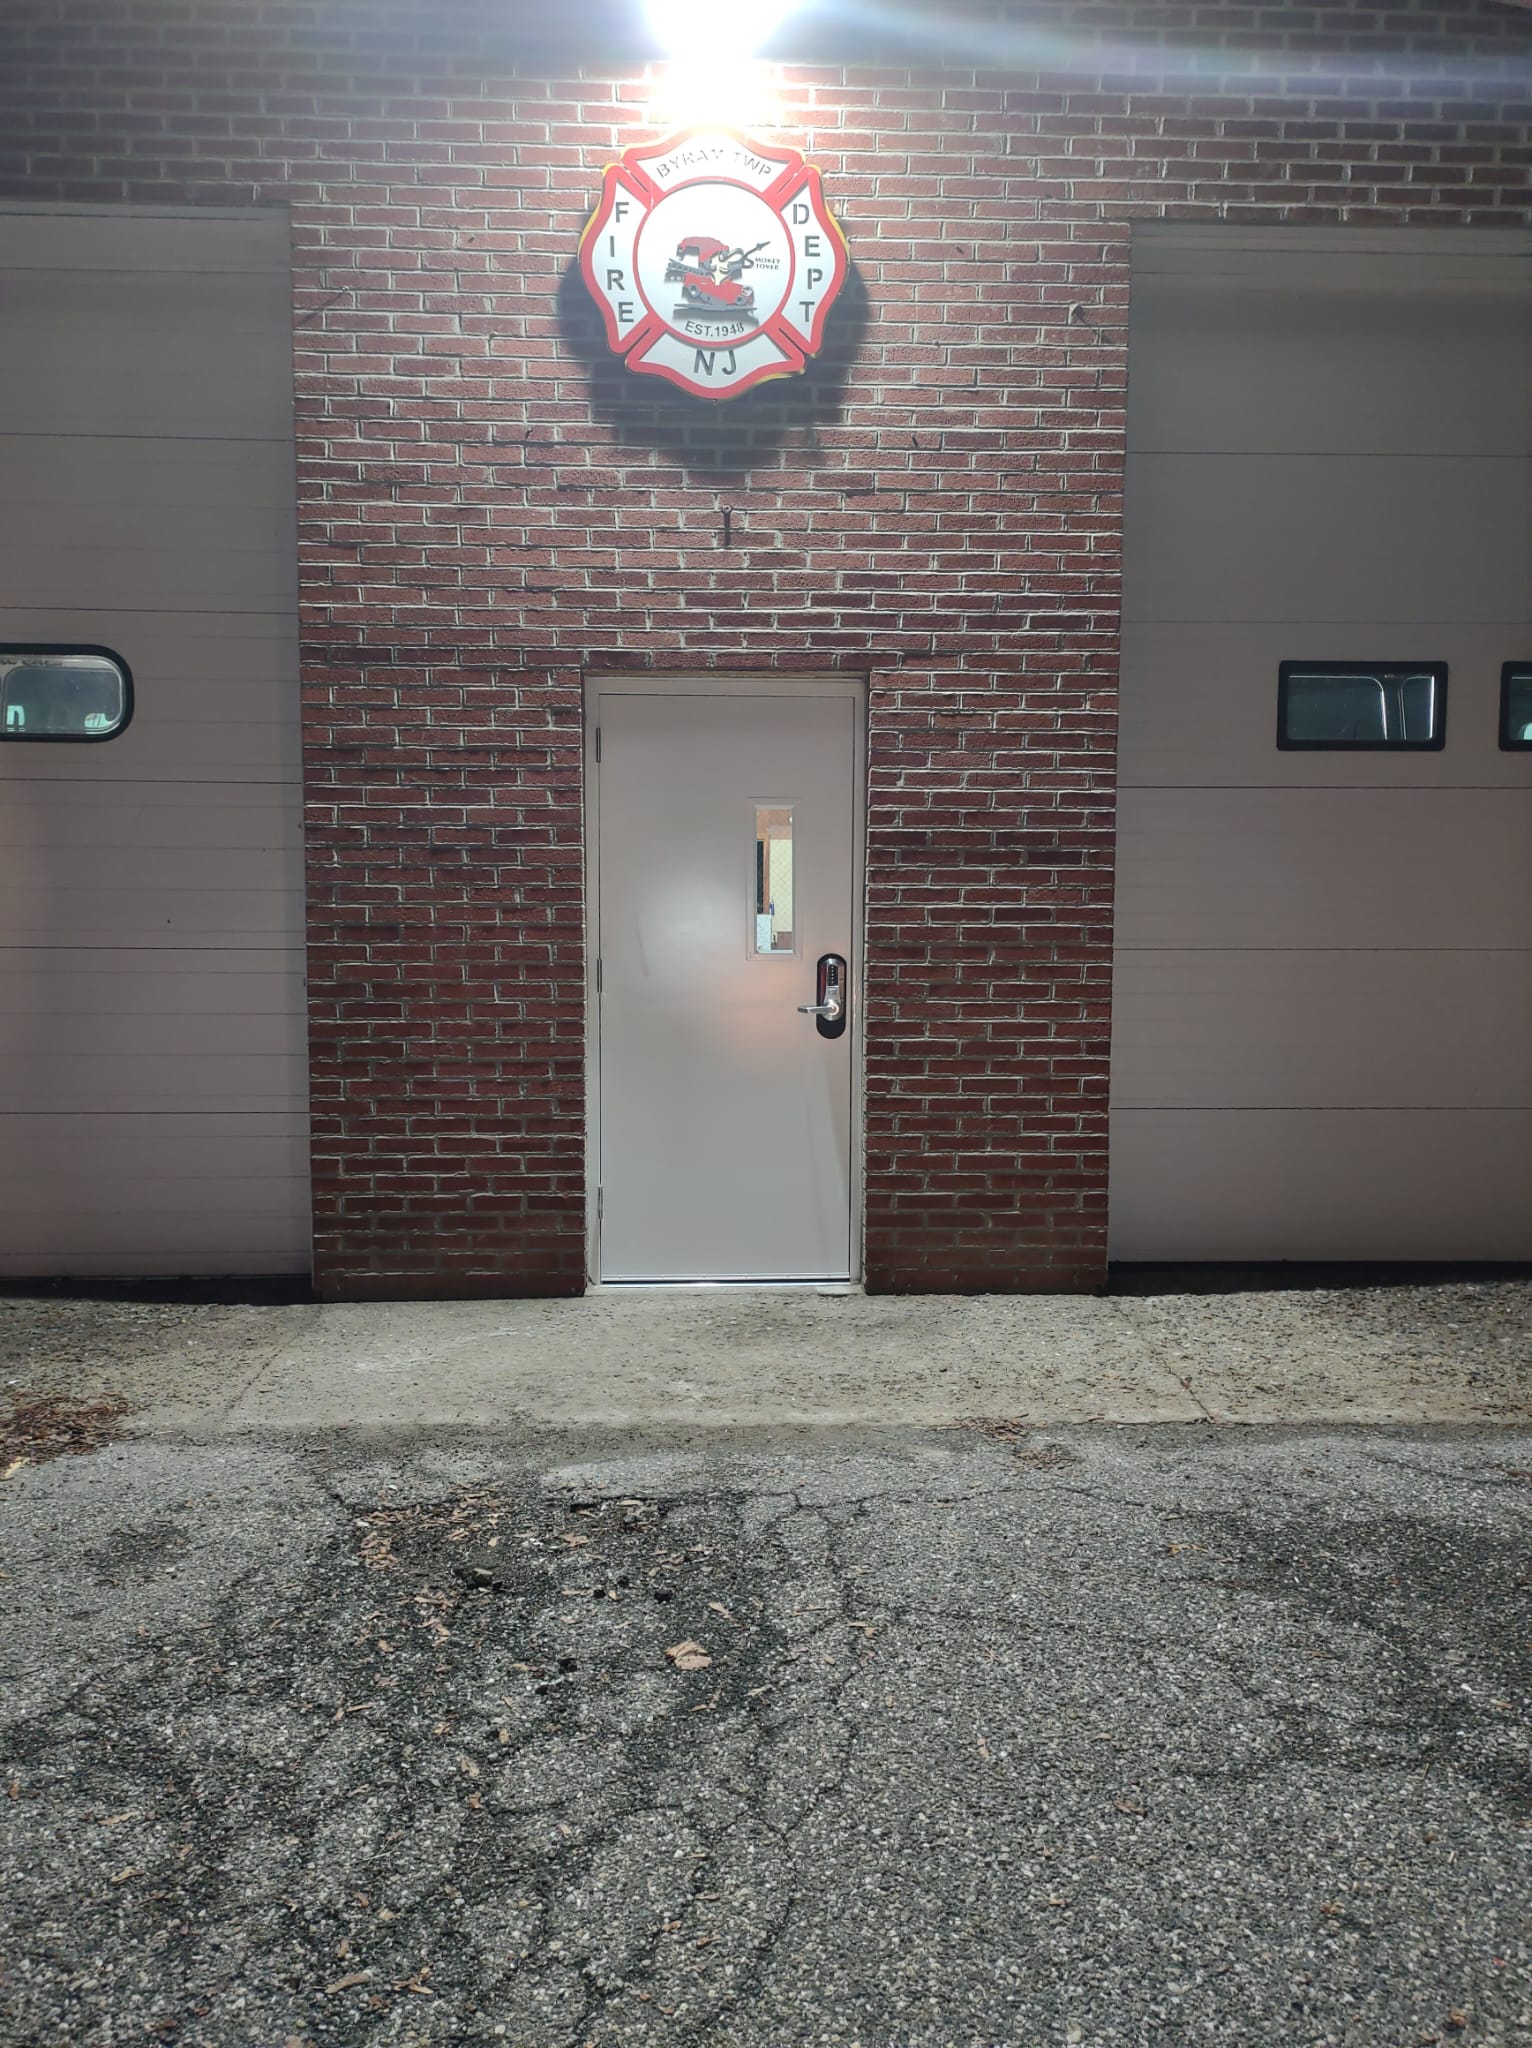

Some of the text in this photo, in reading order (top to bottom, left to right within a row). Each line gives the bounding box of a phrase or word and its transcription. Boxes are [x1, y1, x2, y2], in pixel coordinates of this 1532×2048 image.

[735, 152, 772, 175] TWP
[606, 201, 634, 323] FIRE
[792, 203, 824, 323] DEPT
[693, 349, 737, 377] NJ
